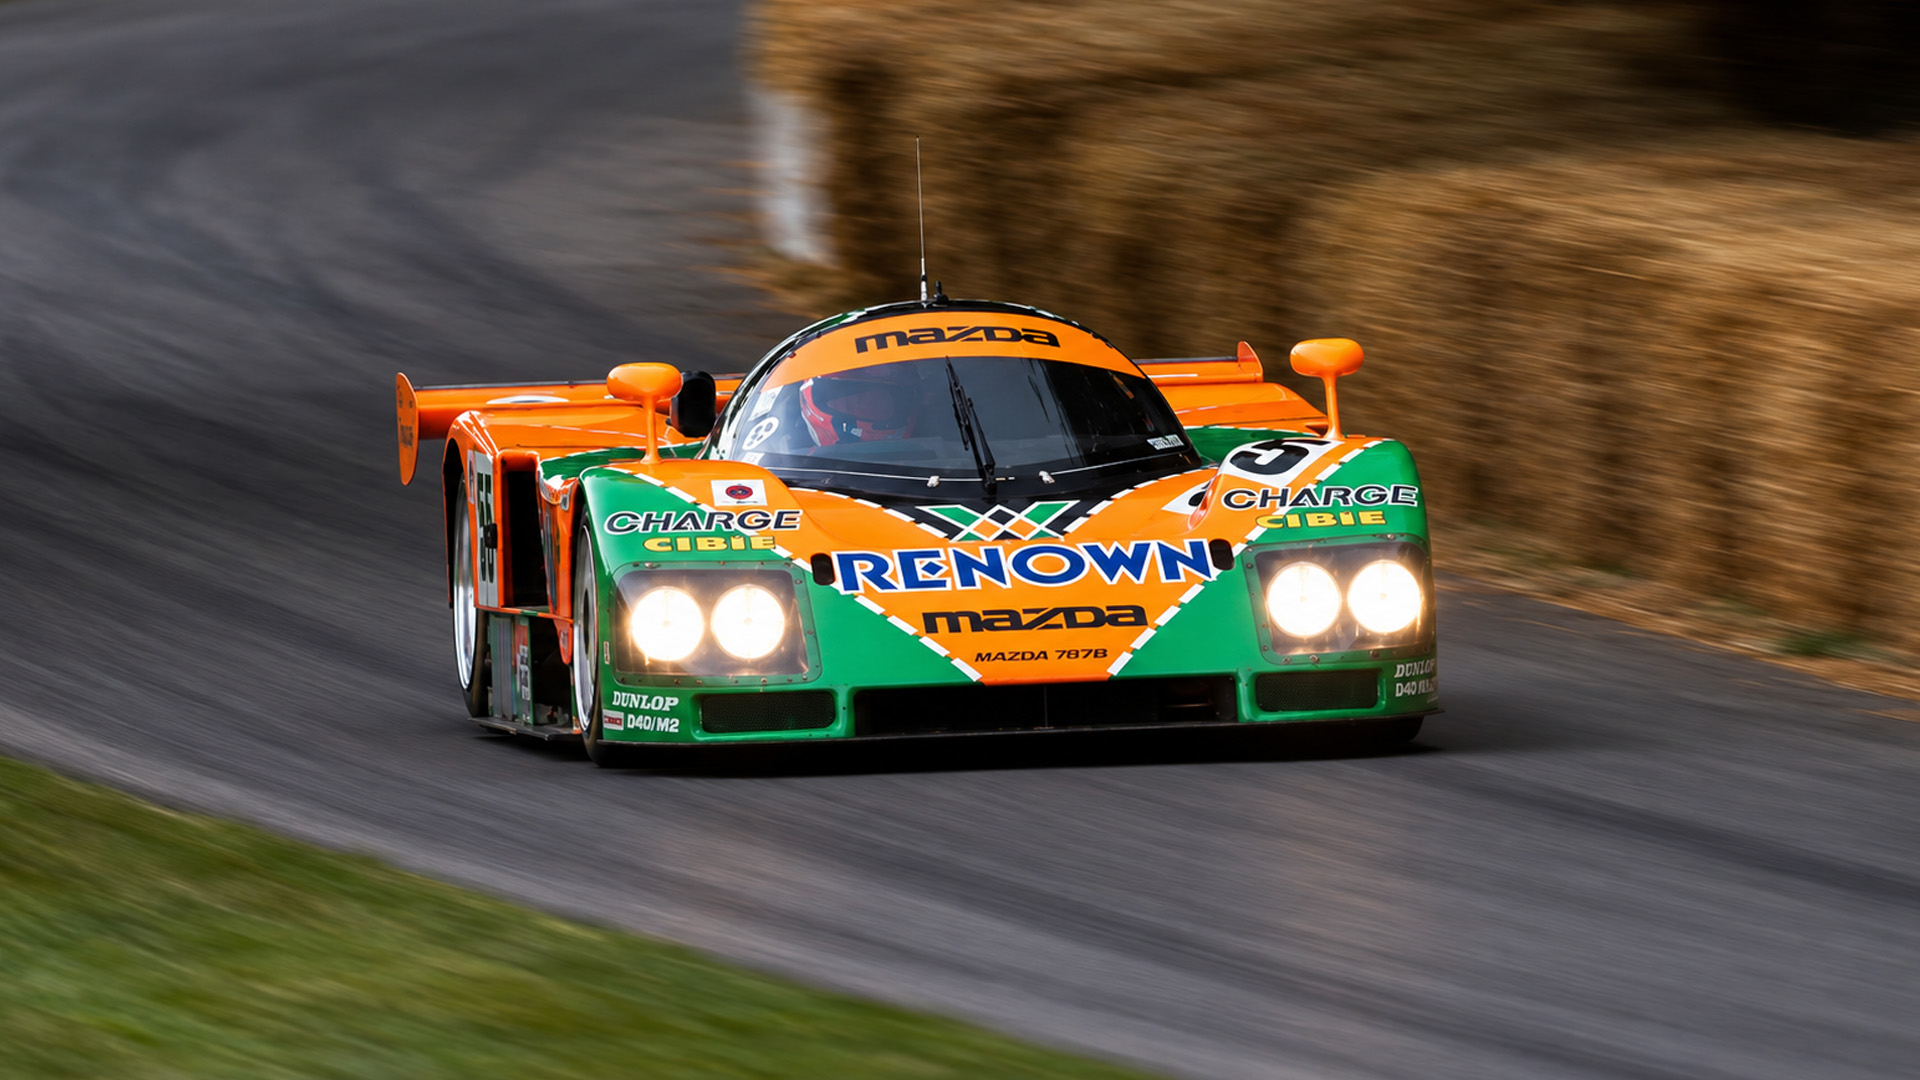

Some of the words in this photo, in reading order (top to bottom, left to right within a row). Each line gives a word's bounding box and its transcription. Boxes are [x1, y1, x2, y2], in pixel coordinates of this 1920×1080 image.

[855, 325, 1061, 354] mazda
[1221, 484, 1419, 511] CHARGE
[604, 509, 803, 535] CHARGE
[831, 538, 1217, 595] RENOWN
[922, 604, 1149, 634] mazda
[974, 650, 1049, 663] MAZDA
[1054, 648, 1109, 660] 787B
[612, 690, 680, 712] DUNLOP
[626, 713, 681, 733] D40/M2
